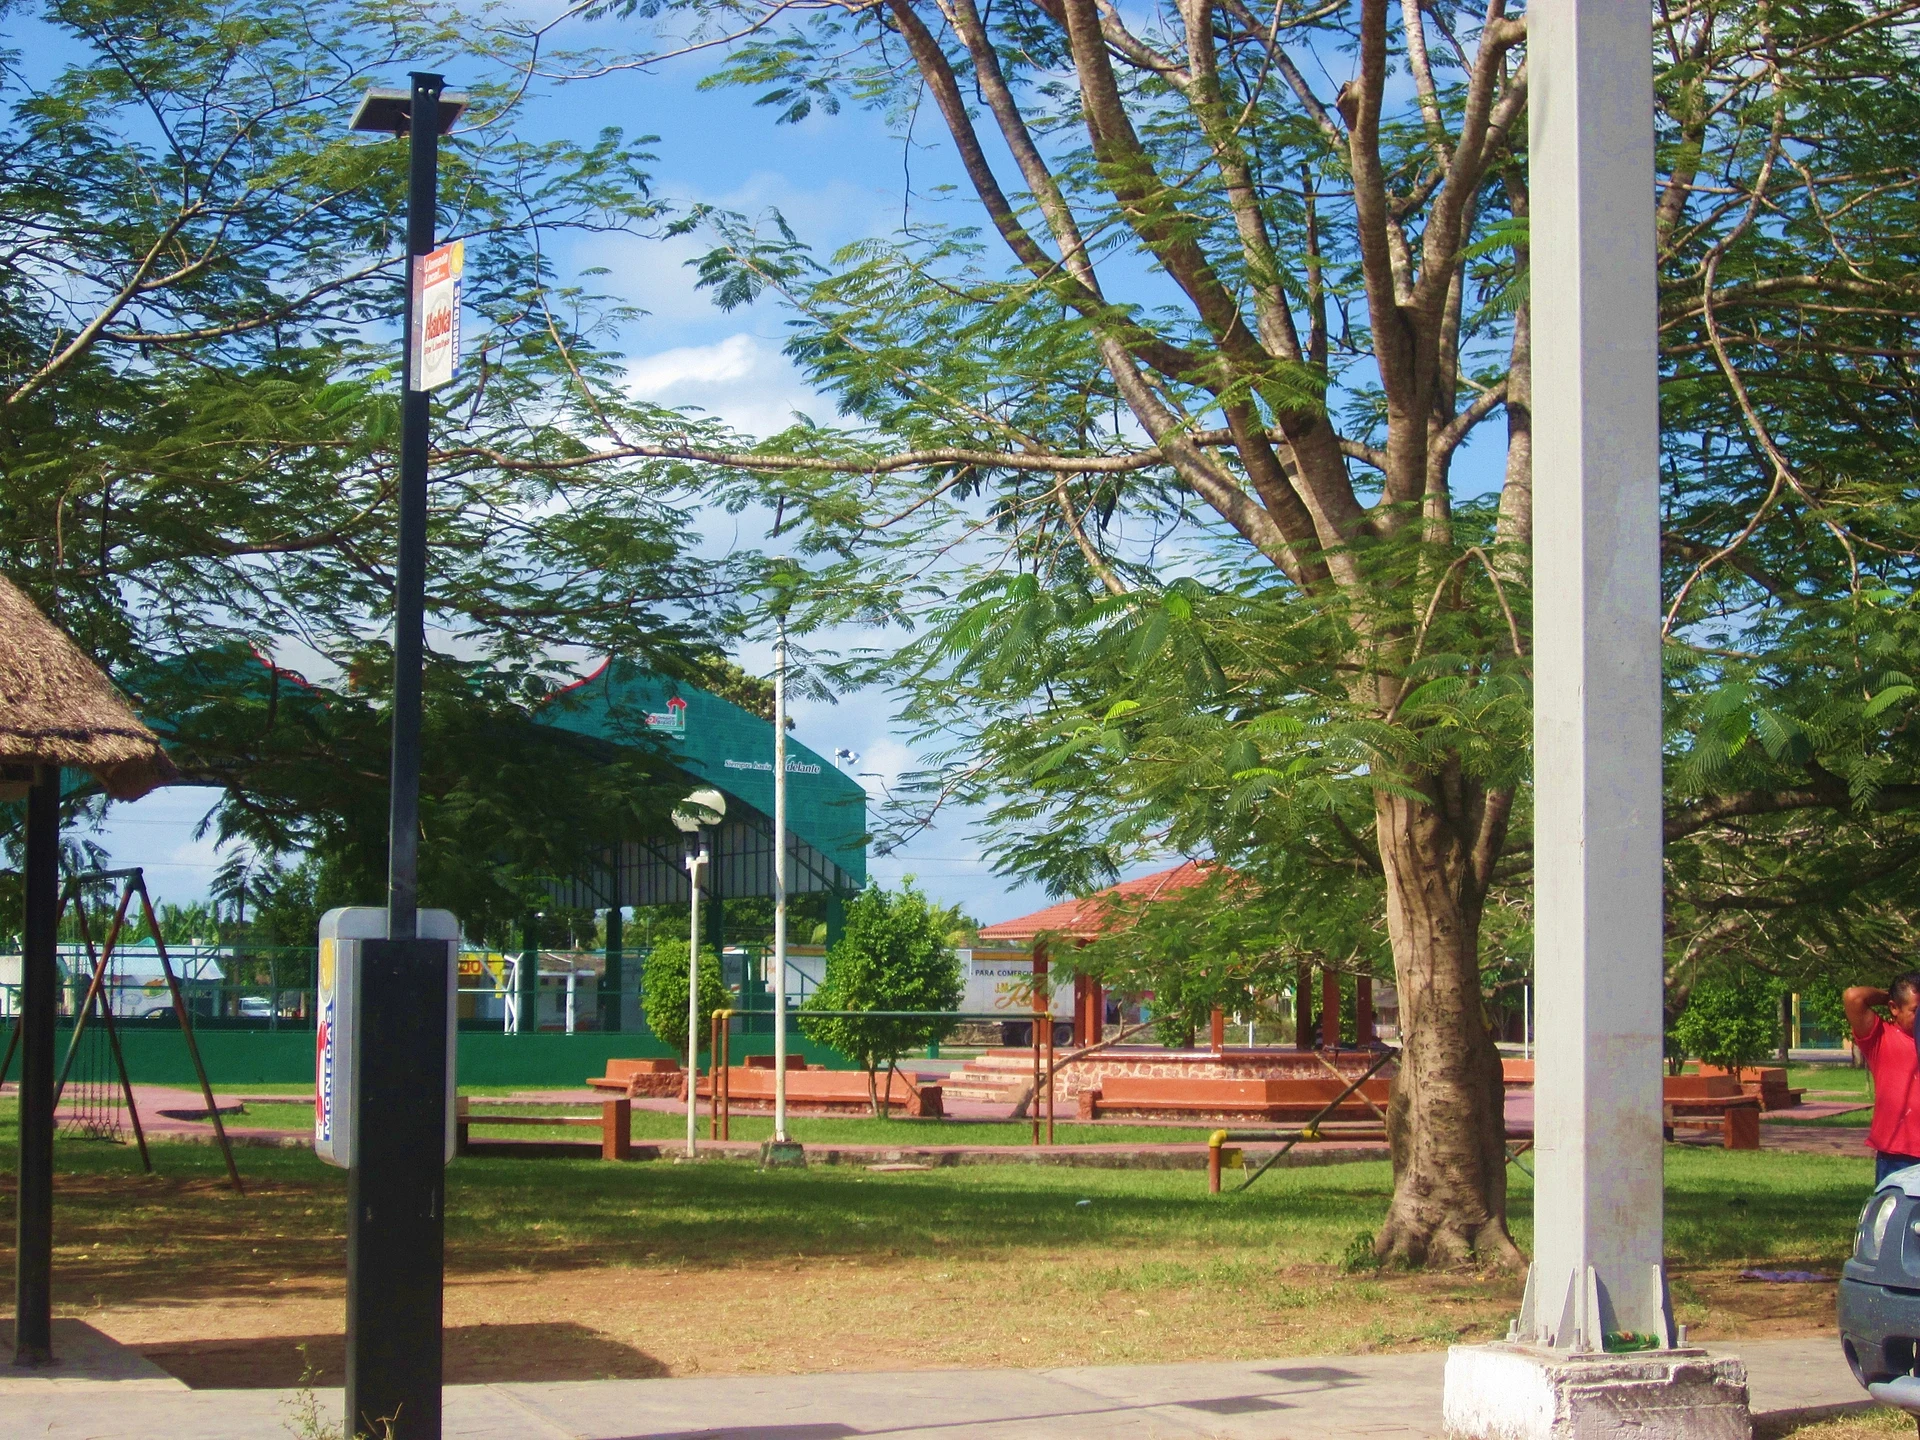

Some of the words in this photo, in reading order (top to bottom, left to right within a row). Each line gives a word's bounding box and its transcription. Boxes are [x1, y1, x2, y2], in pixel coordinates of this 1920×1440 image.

[425, 306, 451, 342] Habla
[724, 759, 752, 770] Siempre
[753, 761, 772, 771] hacia
[324, 1009, 333, 1135] MONEDAS
